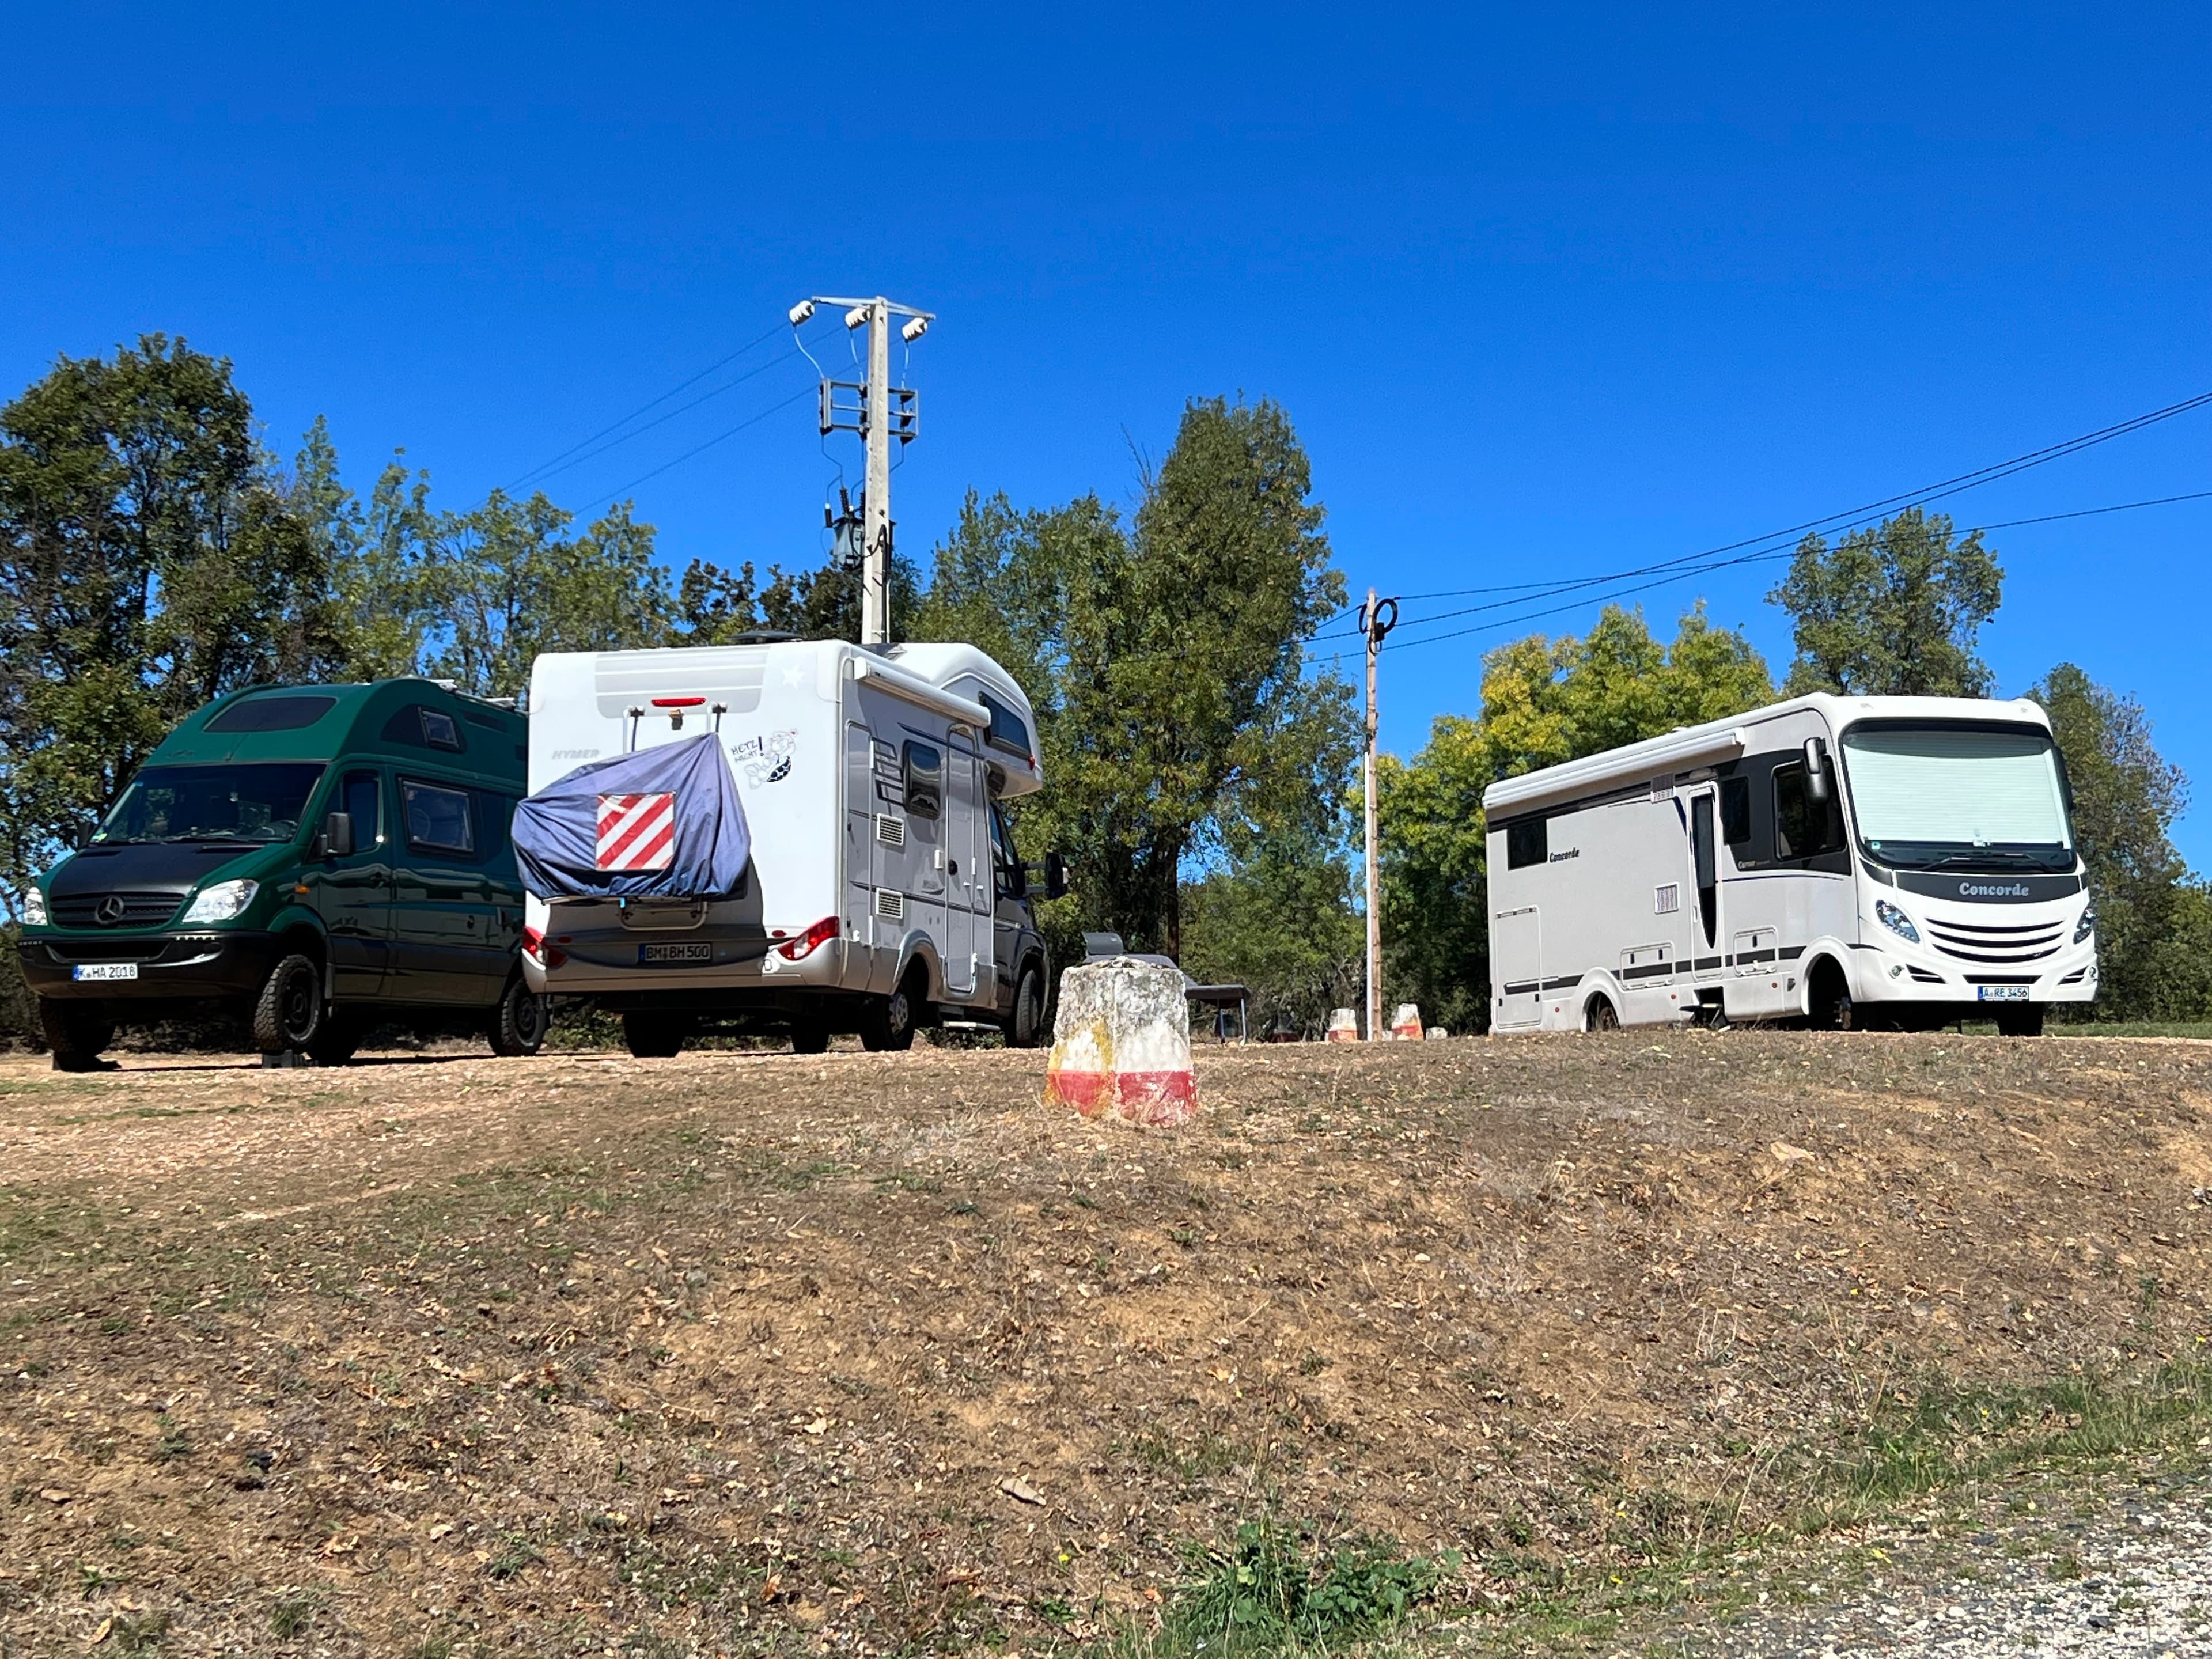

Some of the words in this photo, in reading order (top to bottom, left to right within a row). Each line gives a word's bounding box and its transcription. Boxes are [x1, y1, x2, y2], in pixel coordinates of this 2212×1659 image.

[552, 749, 599, 760] HYMER
[1550, 847, 1580, 863] Concorde
[1959, 882, 2029, 896] Concorde
[646, 946, 662, 959] BM
[669, 946, 685, 958] BH
[687, 945, 709, 958] 500
[93, 966, 107, 978] HA
[109, 965, 135, 978] 2018
[1994, 988, 2005, 997] RE
[2007, 988, 2027, 997] 3456
